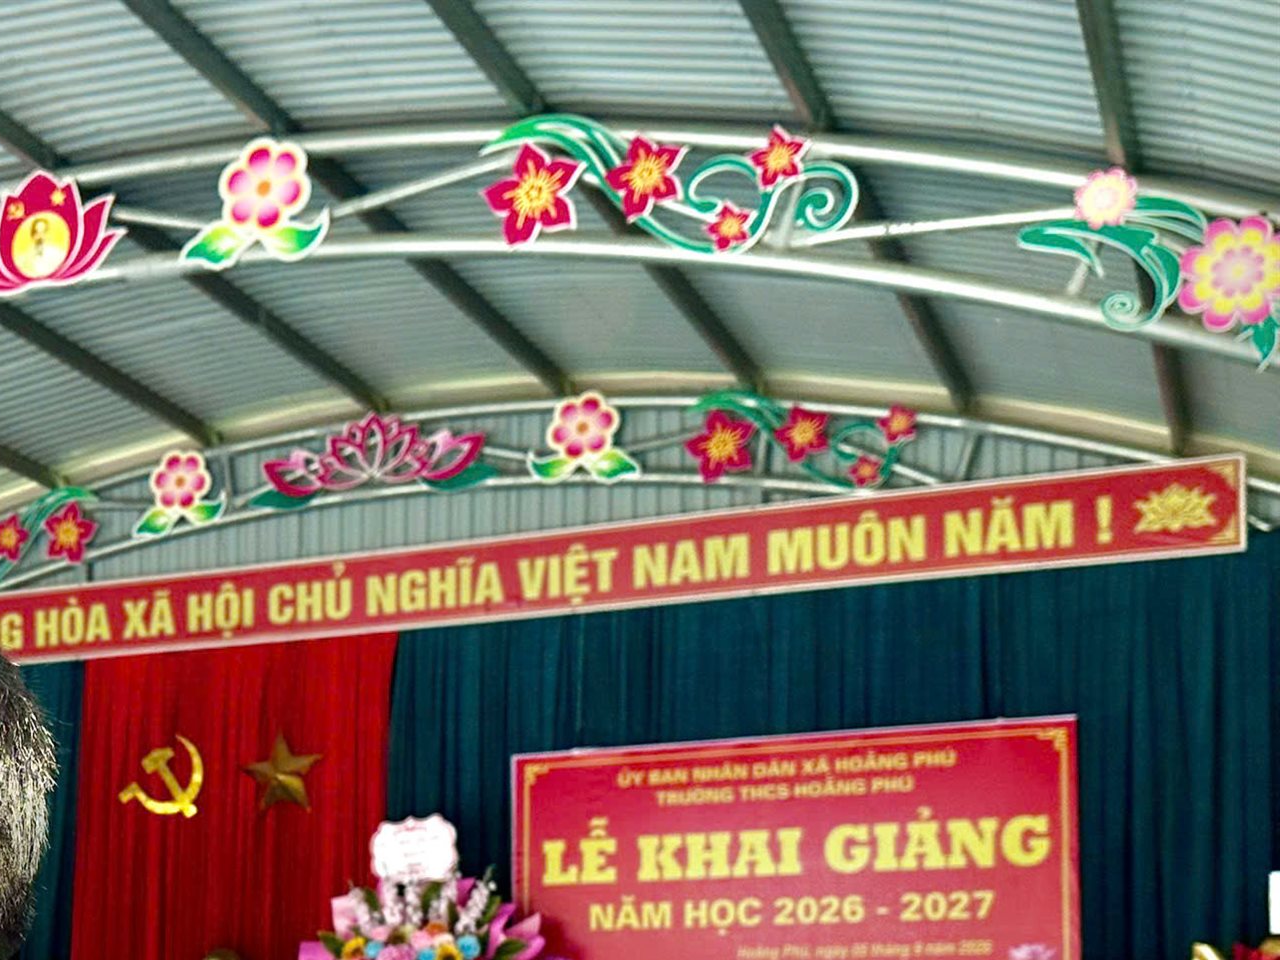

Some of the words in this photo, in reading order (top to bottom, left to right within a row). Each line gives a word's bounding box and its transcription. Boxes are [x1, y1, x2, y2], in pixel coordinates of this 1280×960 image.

[35, 597, 111, 648] HÒA
[123, 590, 176, 640] XÃ
[186, 581, 254, 640] HỘI
[268, 560, 352, 625] CHỦ
[366, 555, 504, 617] NGHĨA
[517, 543, 618, 605] VIỆT
[632, 533, 751, 590] NAM
[768, 509, 926, 575] MUÔN
[943, 495, 1074, 558] NĂM
[1095, 495, 1113, 545] !
[648, 768, 689, 787] BAN
[541, 816, 618, 887] LỄ
[636, 827, 803, 883] KHAI
[824, 806, 1051, 875] GIẢNG
[589, 894, 673, 931] NĂM
[684, 897, 763, 937] HỌC
[773, 894, 865, 926] 2026
[900, 889, 995, 922] 2027
